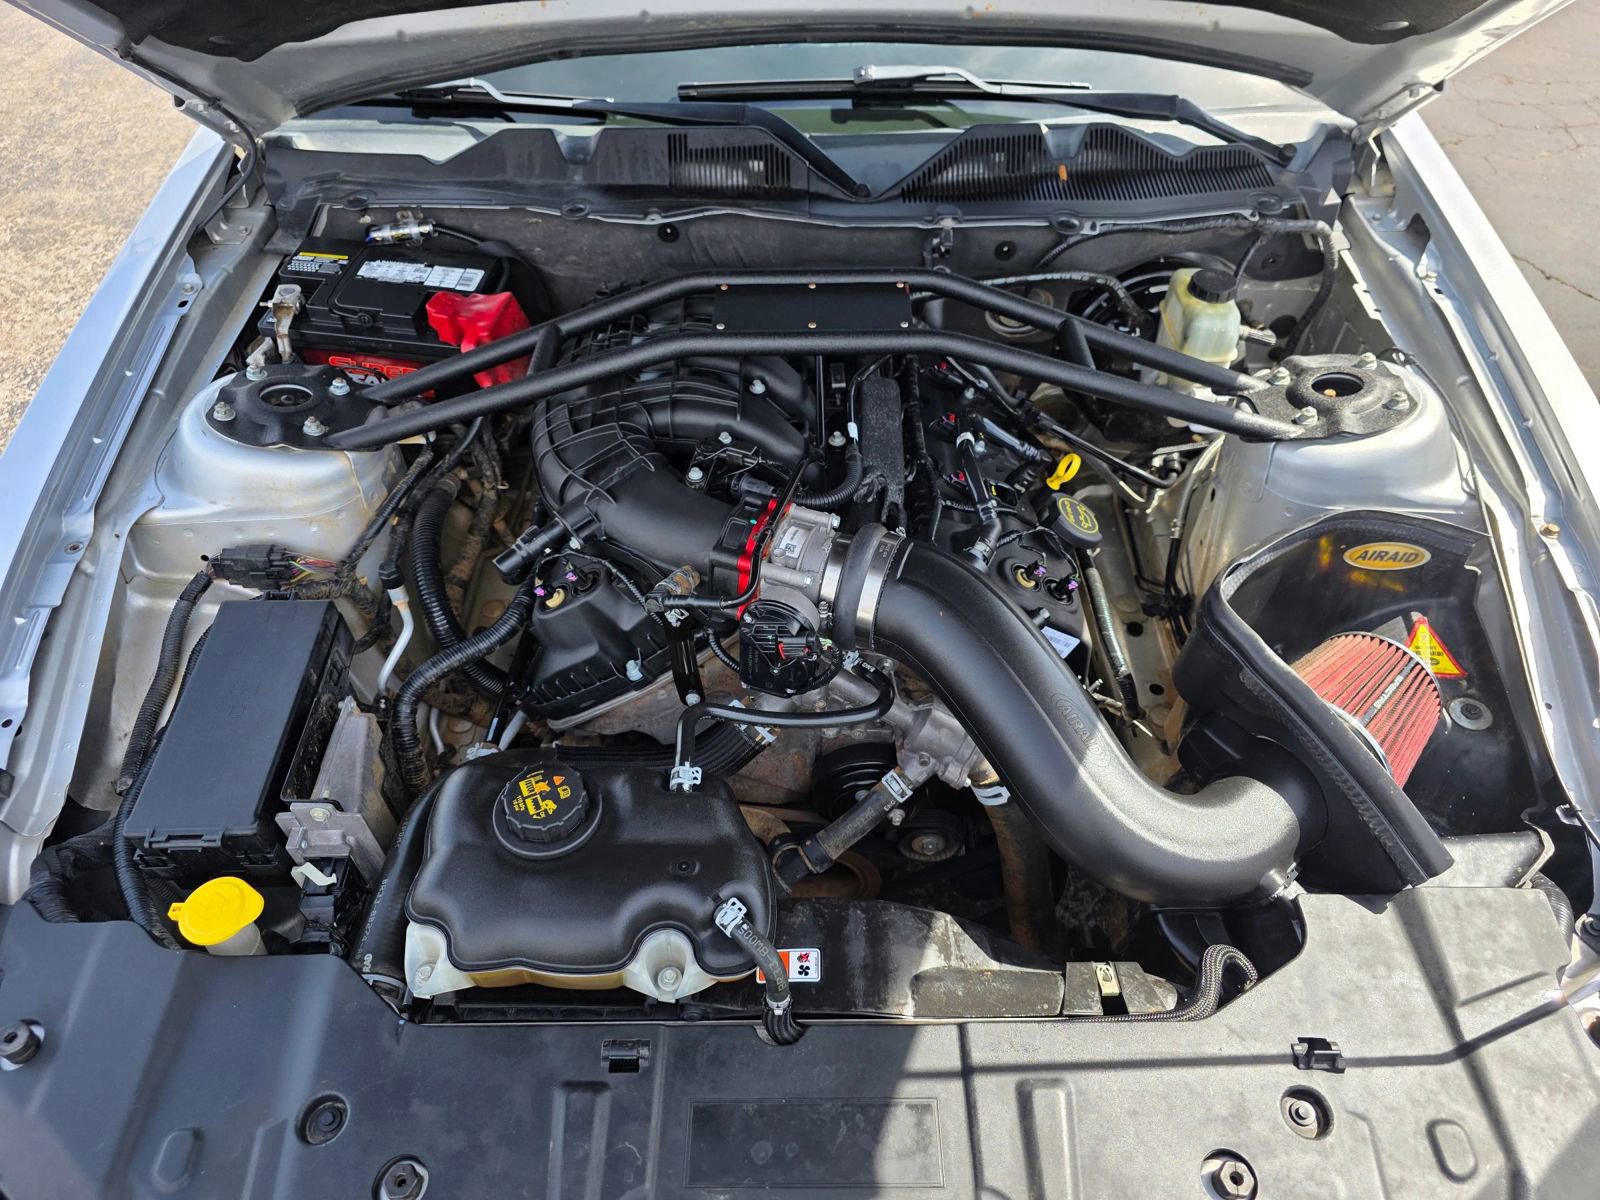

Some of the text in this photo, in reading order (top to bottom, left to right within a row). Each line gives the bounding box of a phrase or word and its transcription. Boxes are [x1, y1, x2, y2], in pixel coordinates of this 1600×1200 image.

[1355, 549, 1420, 564] AIRAID
[1374, 674, 1404, 709] SPECTRE
[1056, 704, 1102, 754] AIRAID
[362, 953, 373, 972] RAD
